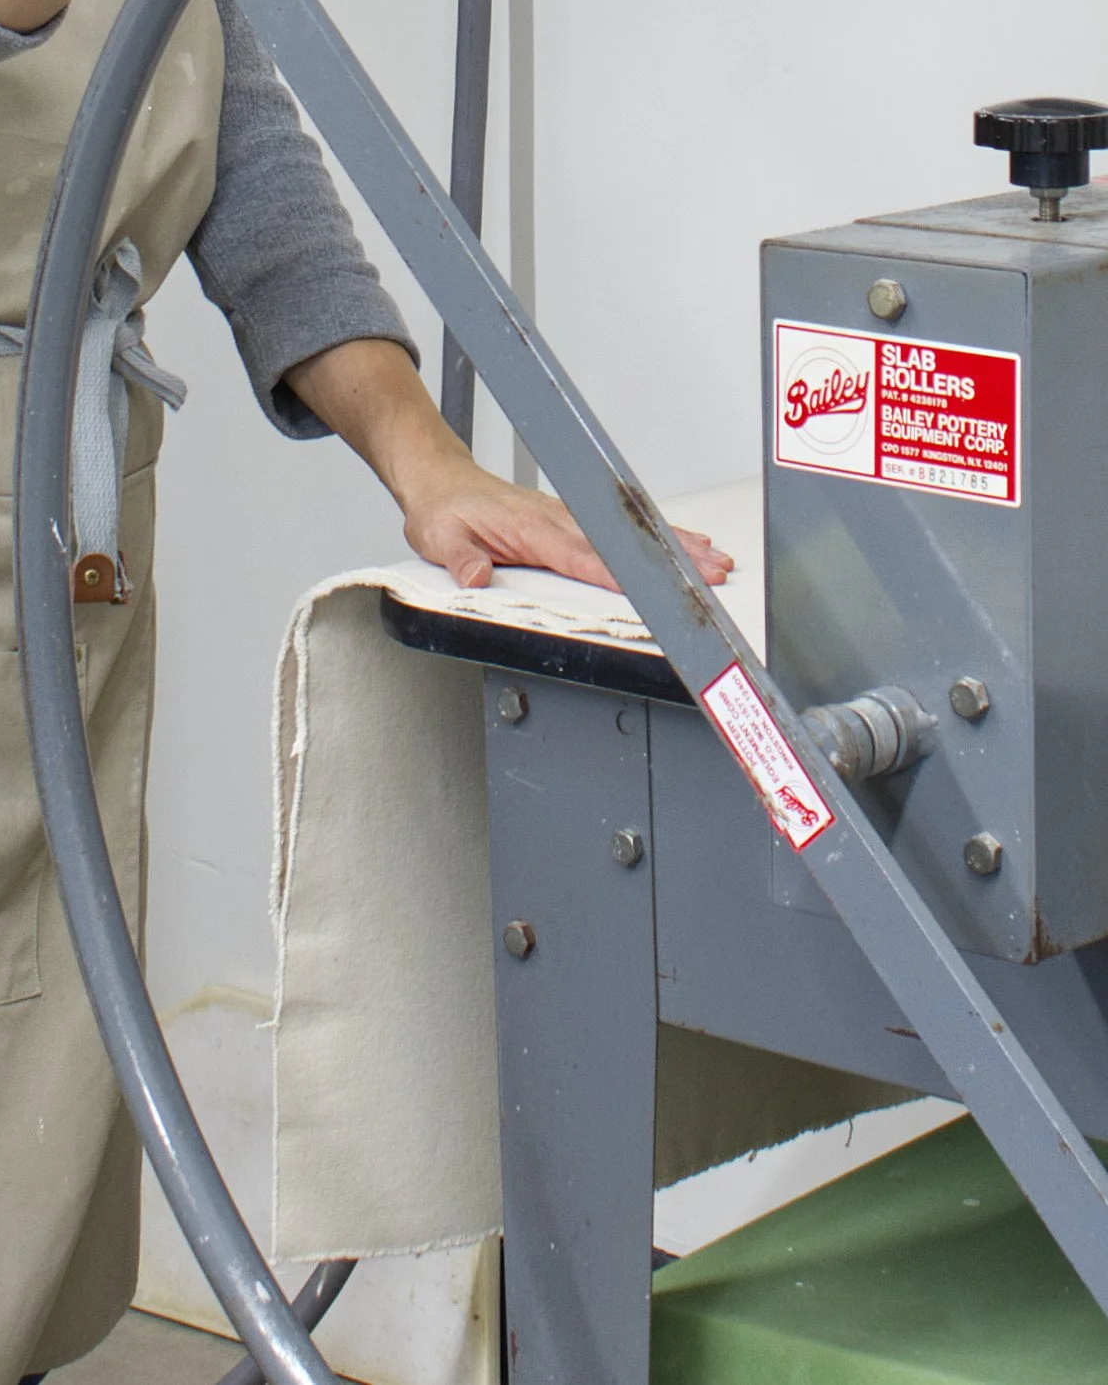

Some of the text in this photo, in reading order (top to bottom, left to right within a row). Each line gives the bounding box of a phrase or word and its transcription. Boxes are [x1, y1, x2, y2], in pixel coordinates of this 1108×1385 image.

[881, 344, 936, 372] SLAB
[881, 366, 975, 400] ROLLERS
[881, 389, 902, 403] PAT.
[784, 368, 870, 429] Bailey
[881, 405, 1008, 439] BAILEY POTTERY
[882, 421, 1008, 456] EQUIPMENT CORP.
[882, 443, 900, 454] CPO
[901, 445, 920, 457] 1577
[922, 451, 966, 465] KINGSTON,
[984, 459, 1008, 473] 12401
[885, 463, 906, 475] SER.
[732, 674, 750, 703] 12401
[734, 697, 751, 719] 1577
[750, 703, 762, 717] NY
[726, 720, 757, 767] POTTERY
[750, 721, 764, 741] BOX
[742, 721, 780, 784] EQUIPMENT
[776, 785, 820, 827] Bailey
